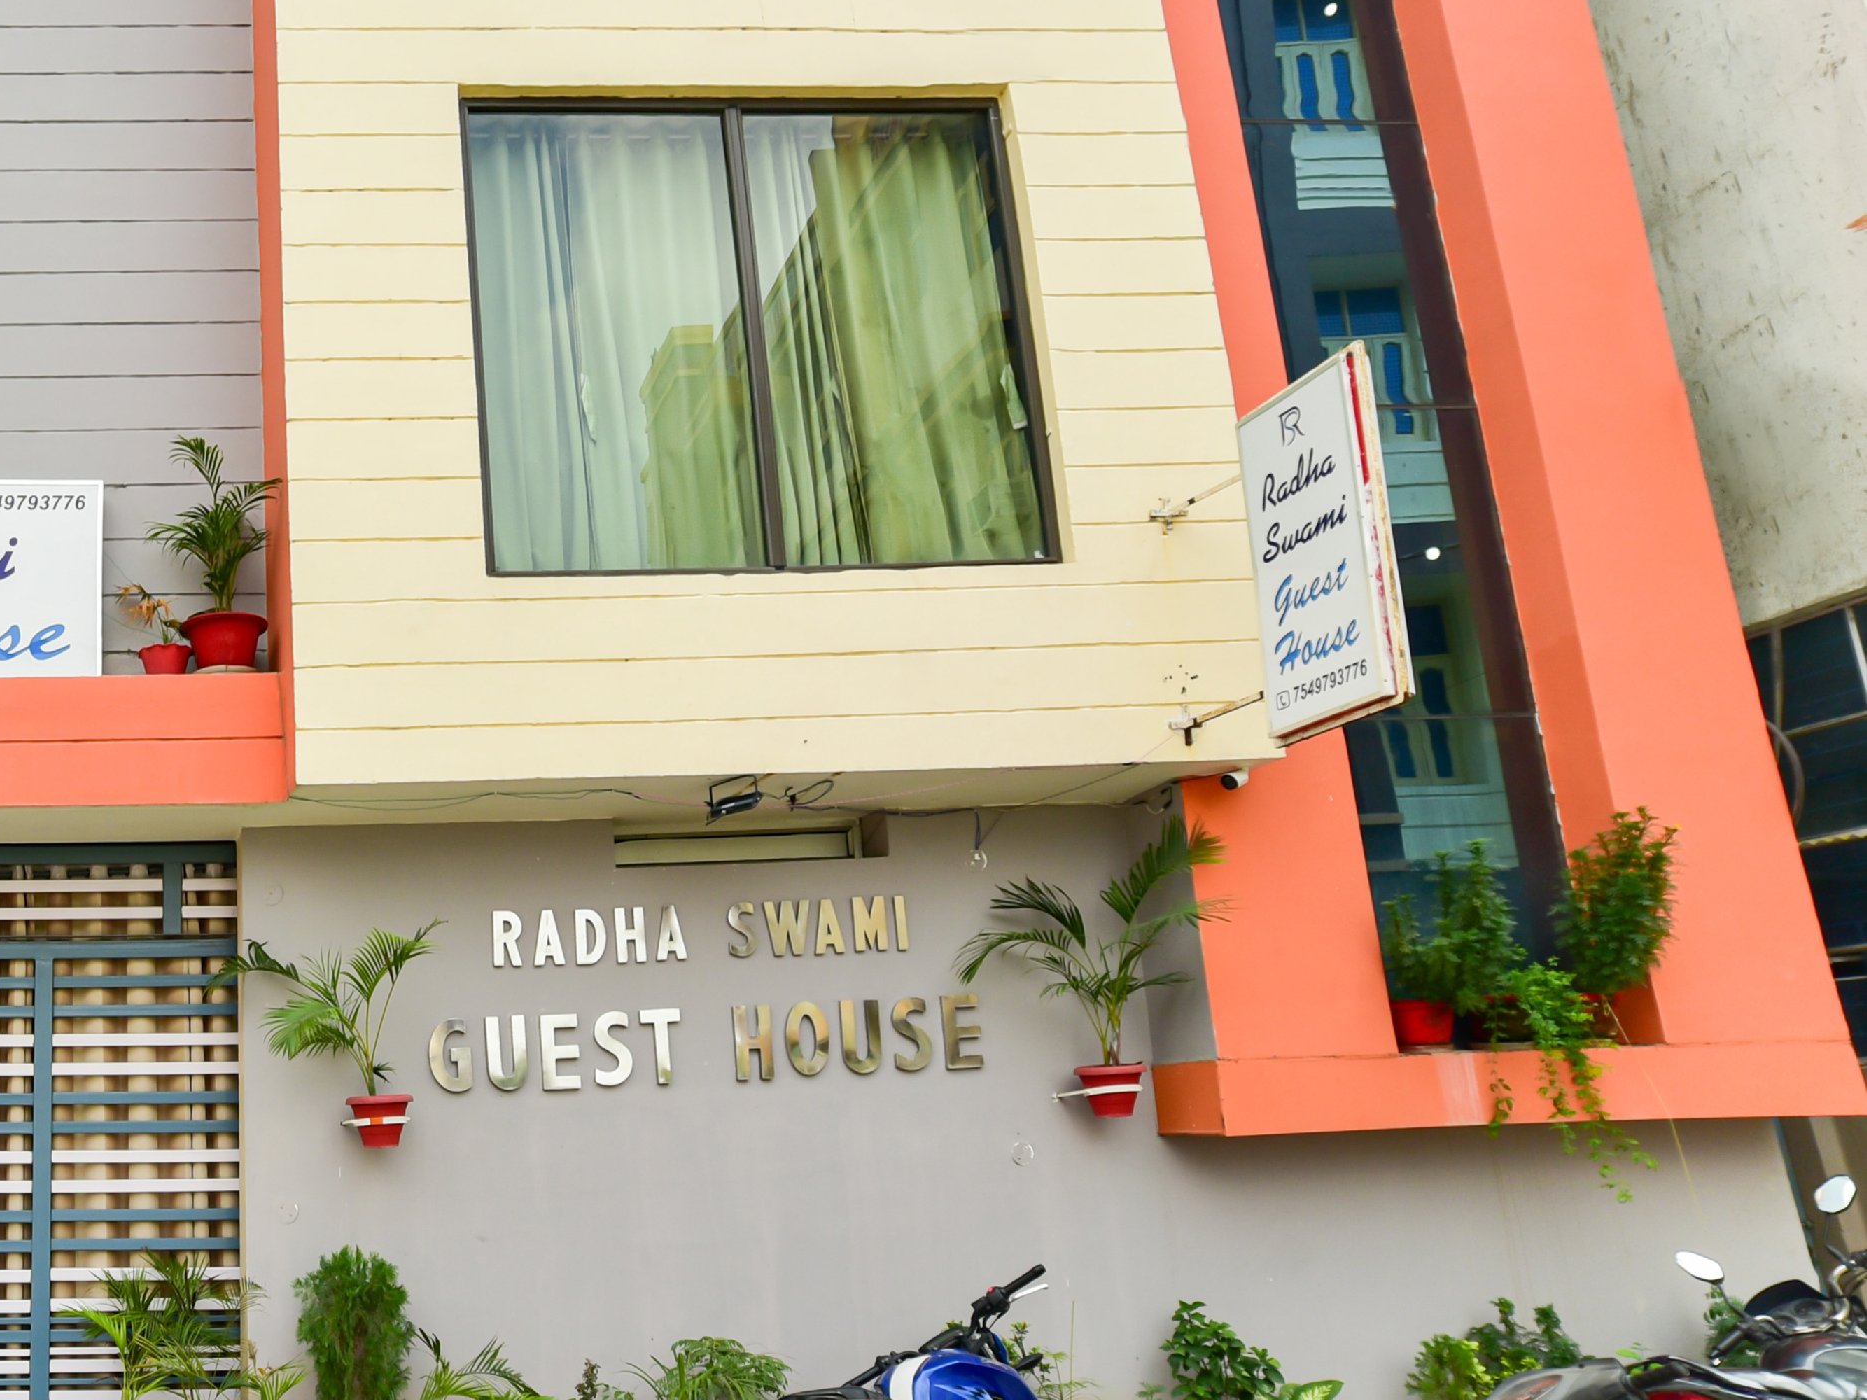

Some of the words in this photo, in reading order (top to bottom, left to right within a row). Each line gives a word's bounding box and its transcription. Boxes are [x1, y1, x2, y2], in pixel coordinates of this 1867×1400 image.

[1262, 447, 1336, 512] Radha
[1262, 494, 1347, 563] Swami
[1274, 557, 1350, 627] Guest
[1274, 618, 1360, 676] House
[1293, 658, 1368, 703] 7549793776
[491, 904, 688, 968] RADHA
[727, 894, 909, 958] SWAMI
[429, 1007, 681, 1093] GUEST
[734, 993, 985, 1082] HOUSE
